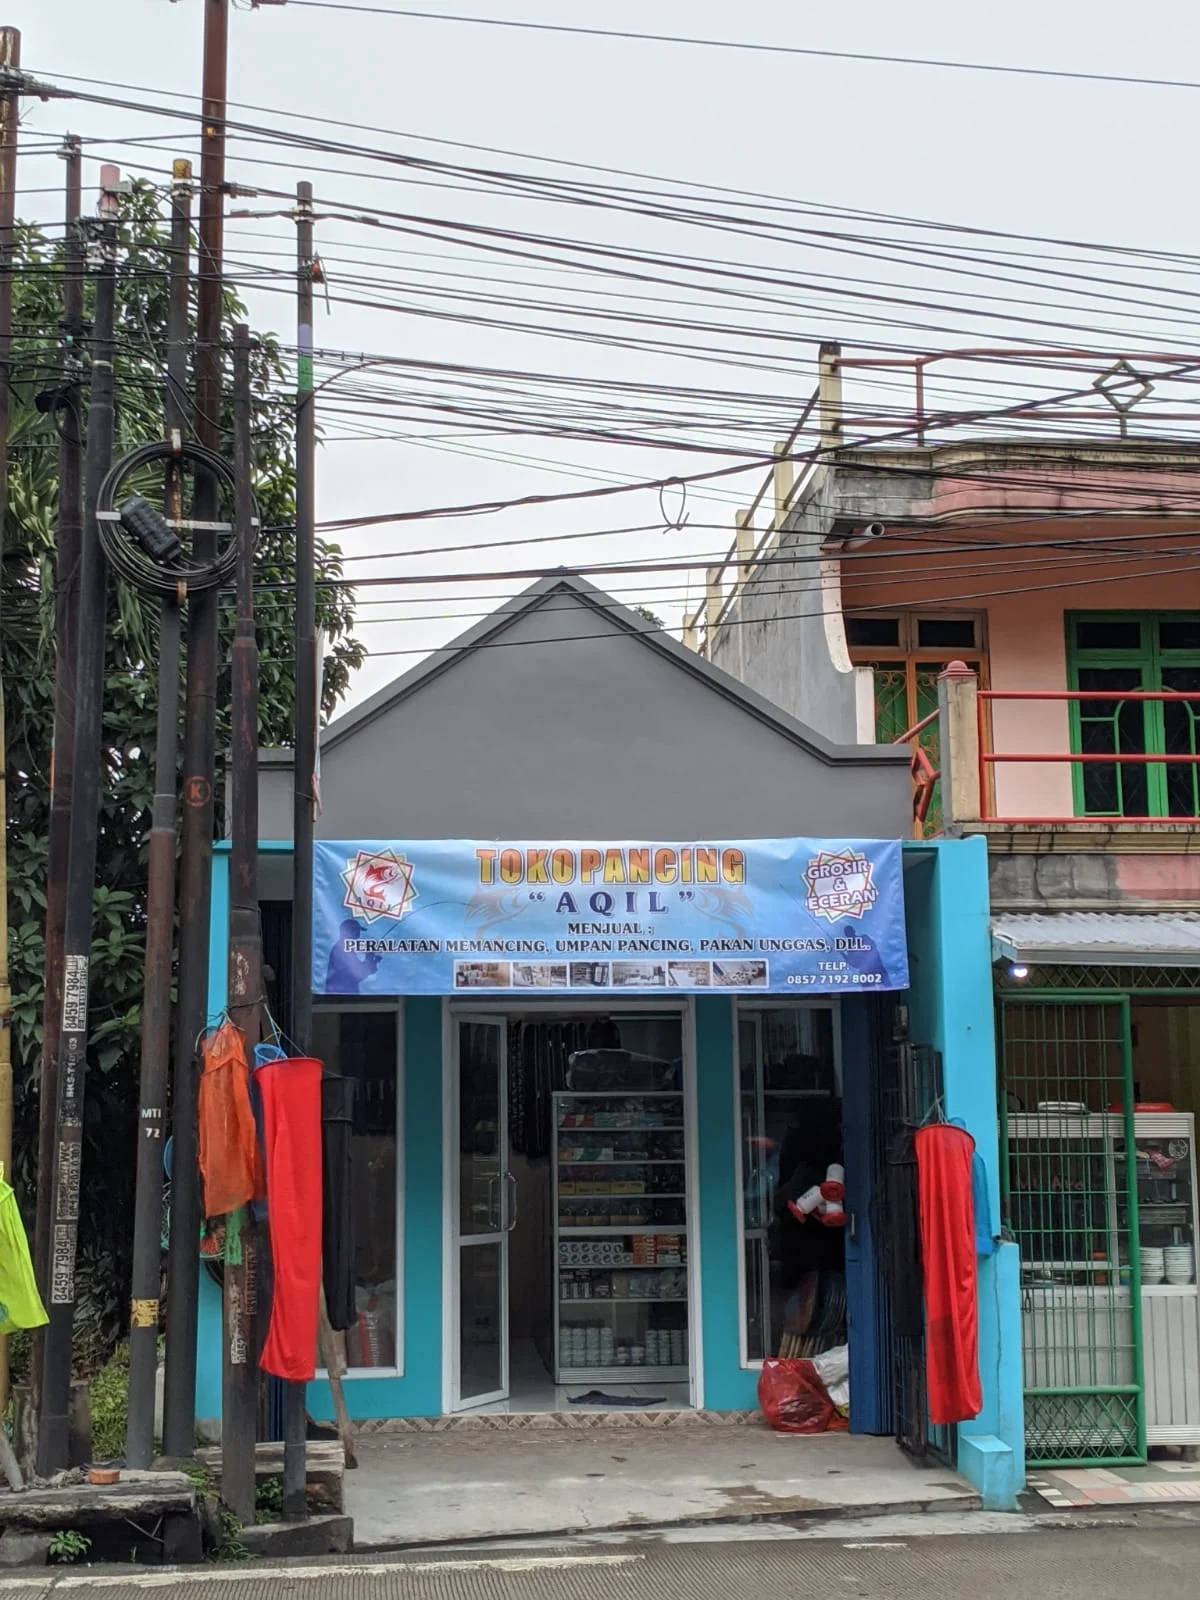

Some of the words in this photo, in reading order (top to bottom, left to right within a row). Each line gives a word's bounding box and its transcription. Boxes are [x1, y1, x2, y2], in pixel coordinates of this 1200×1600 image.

[476, 848, 574, 885] TOKO
[580, 847, 746, 885] PANCING
[807, 859, 870, 880] GROSIR
[832, 877, 848, 892] &
[806, 888, 878, 912] ECERAN
[345, 939, 440, 952] PERALATAN
[446, 939, 550, 954] MEMANCING,
[555, 939, 612, 952] UMPAN
[618, 939, 694, 953] PANCING,
[700, 938, 753, 951] PAKAN
[759, 938, 830, 952] UNGGAS,
[835, 938, 871, 951] DLL.
[818, 961, 850, 971] TELP.
[66, 970, 80, 998] 7984
[787, 975, 816, 985] 0857
[820, 974, 849, 984] 7192
[852, 973, 882, 984] 8002
[64, 1002, 78, 1029] 8459
[141, 1108, 161, 1119] MTI
[145, 1127, 160, 1138] 72
[56, 1240, 70, 1269] 7984
[54, 1273, 68, 1301] 8459
